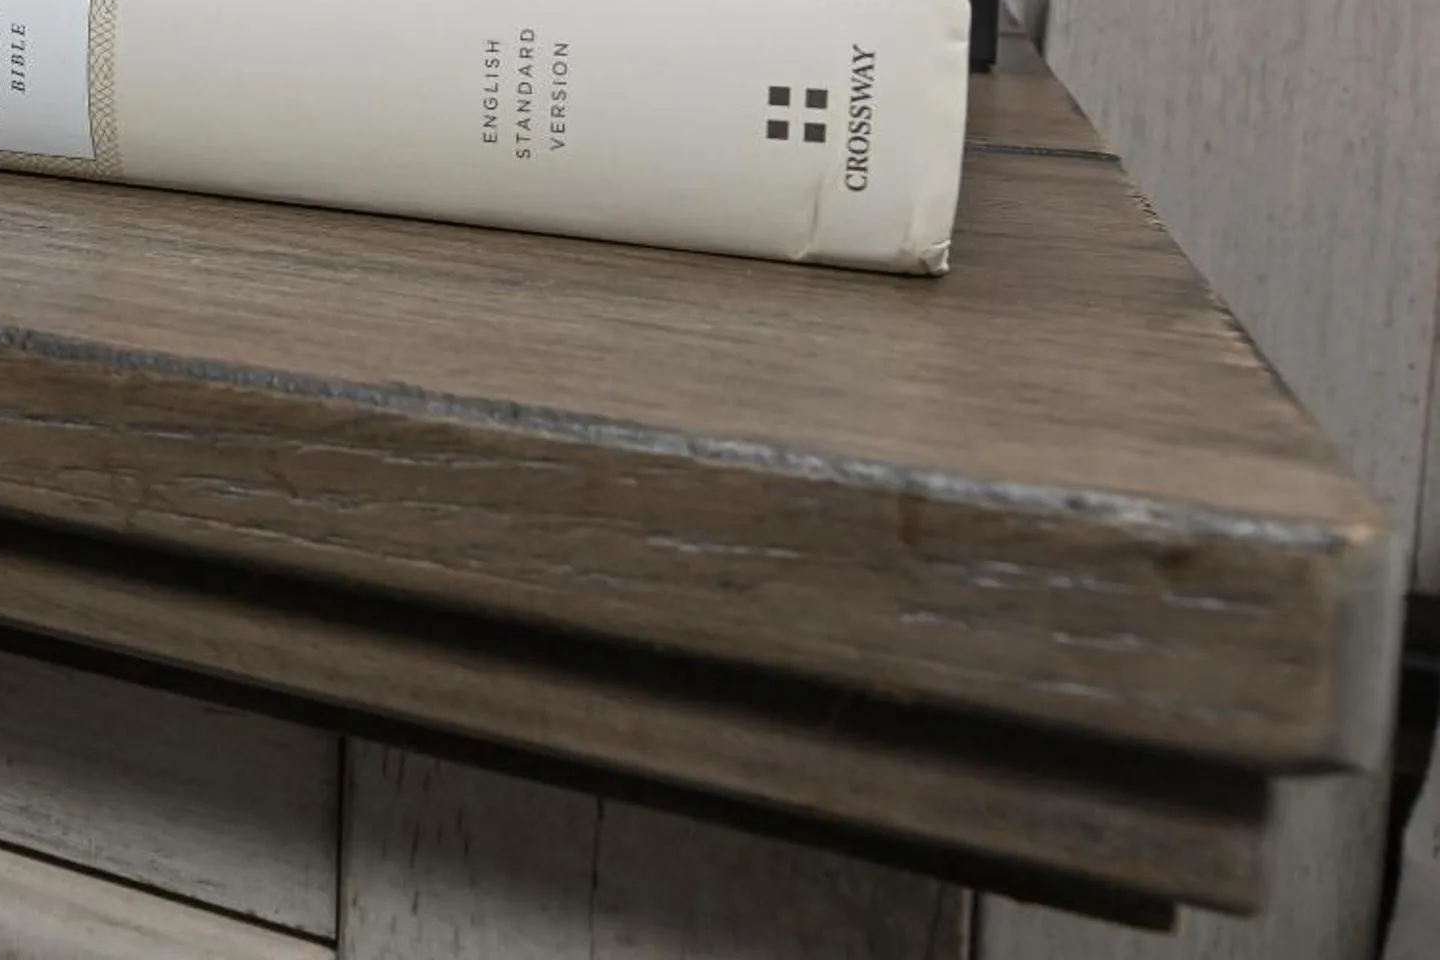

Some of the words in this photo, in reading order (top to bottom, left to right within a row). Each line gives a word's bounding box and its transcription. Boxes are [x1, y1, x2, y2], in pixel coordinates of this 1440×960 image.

[10, 22, 26, 93] BIBLE
[481, 39, 501, 144] ENGLISH
[515, 27, 536, 159] STANDARD
[550, 40, 570, 151] VERSION
[845, 44, 877, 193] CROSSWAY
